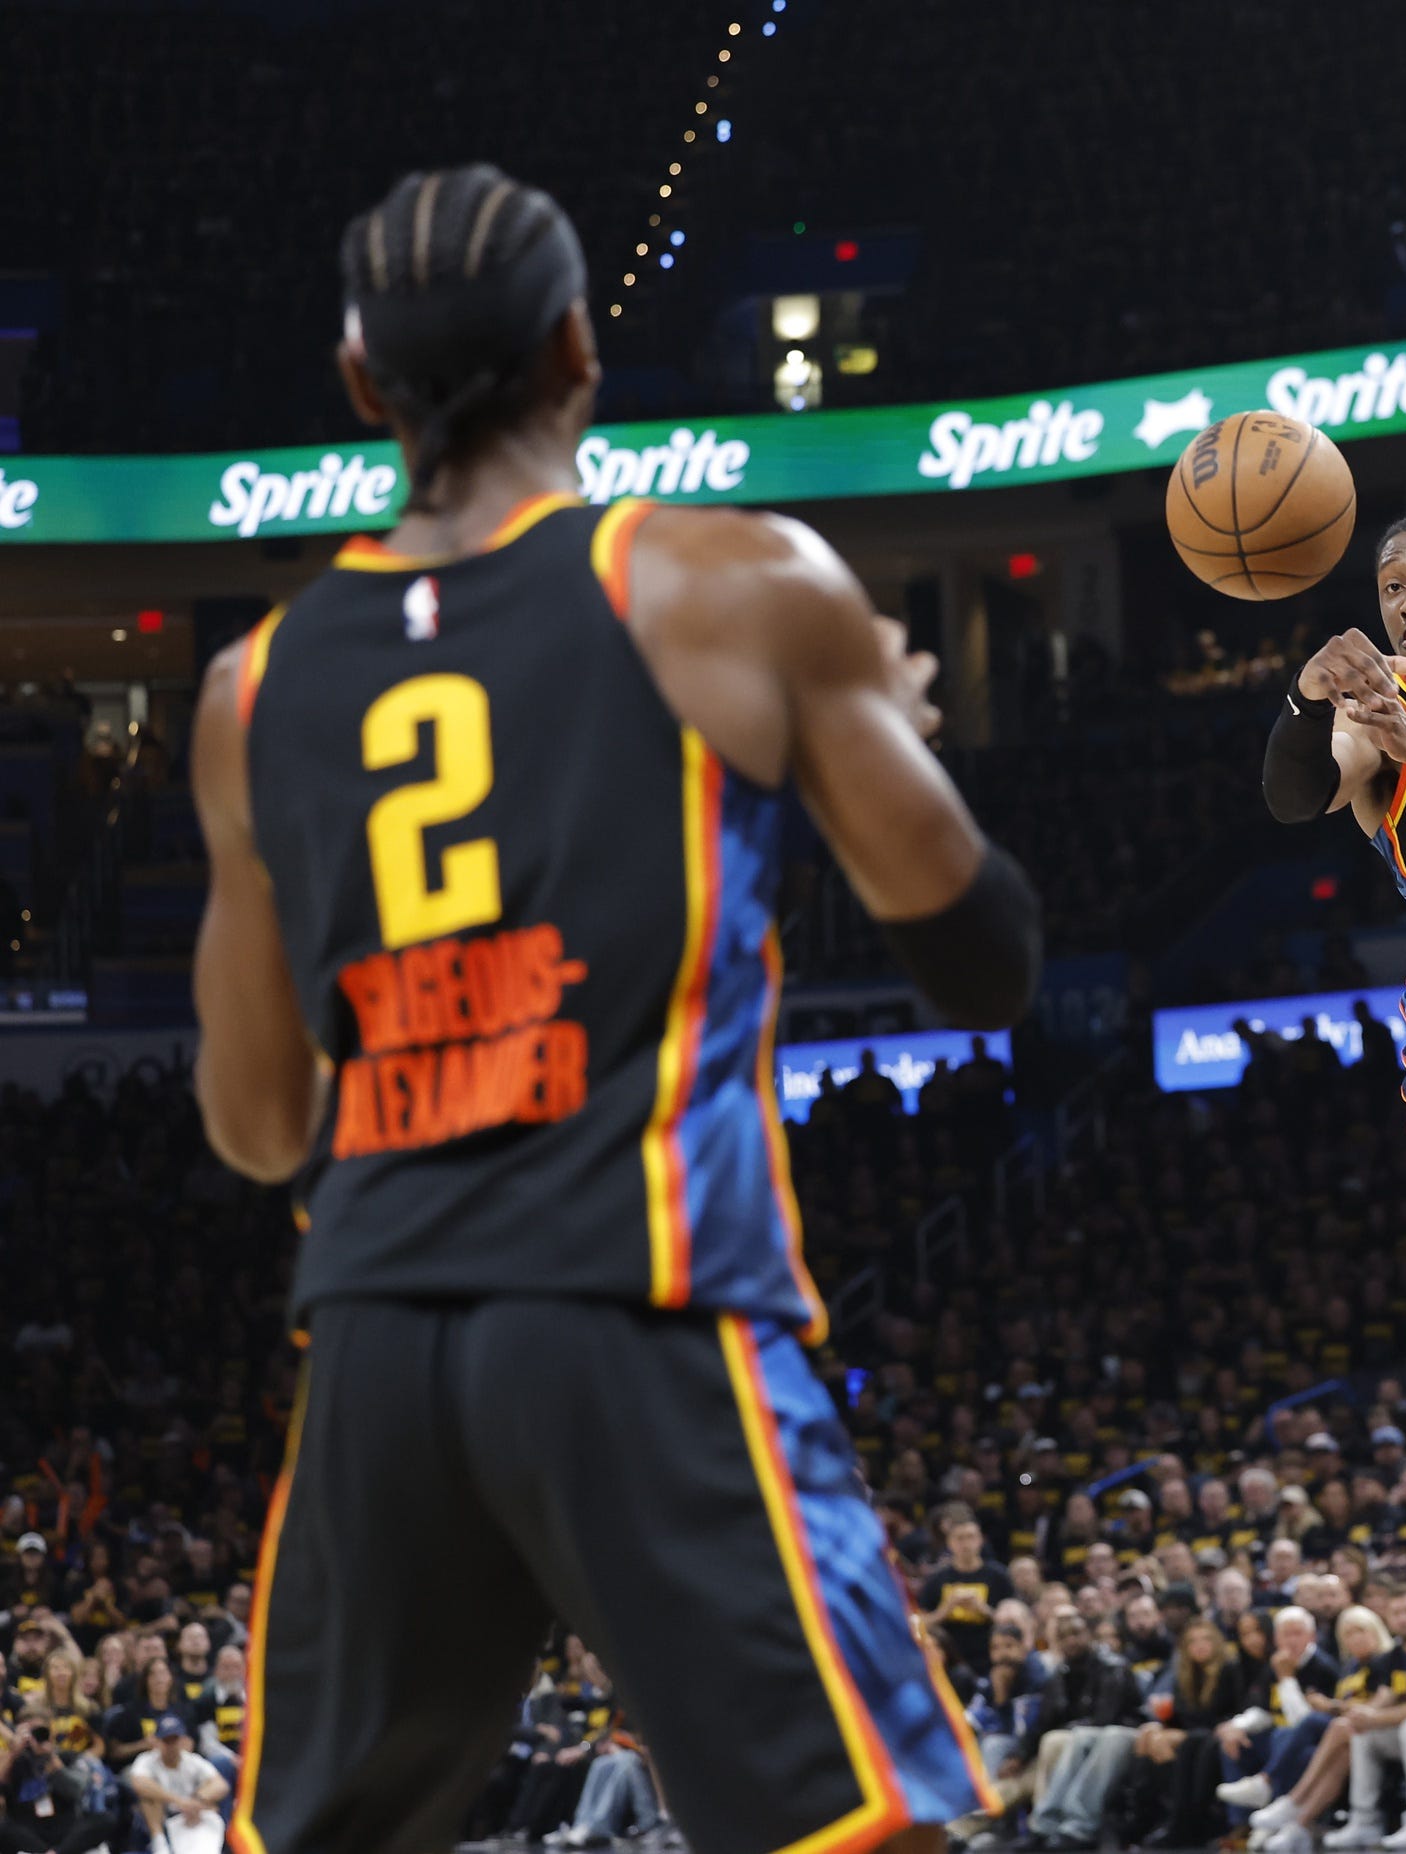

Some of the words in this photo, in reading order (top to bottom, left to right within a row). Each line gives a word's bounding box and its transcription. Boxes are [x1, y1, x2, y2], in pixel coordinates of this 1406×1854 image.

[575, 427, 750, 504] Sprite
[918, 400, 1104, 489] Sprite
[208, 452, 397, 538] Sprite
[361, 673, 502, 950] 2
